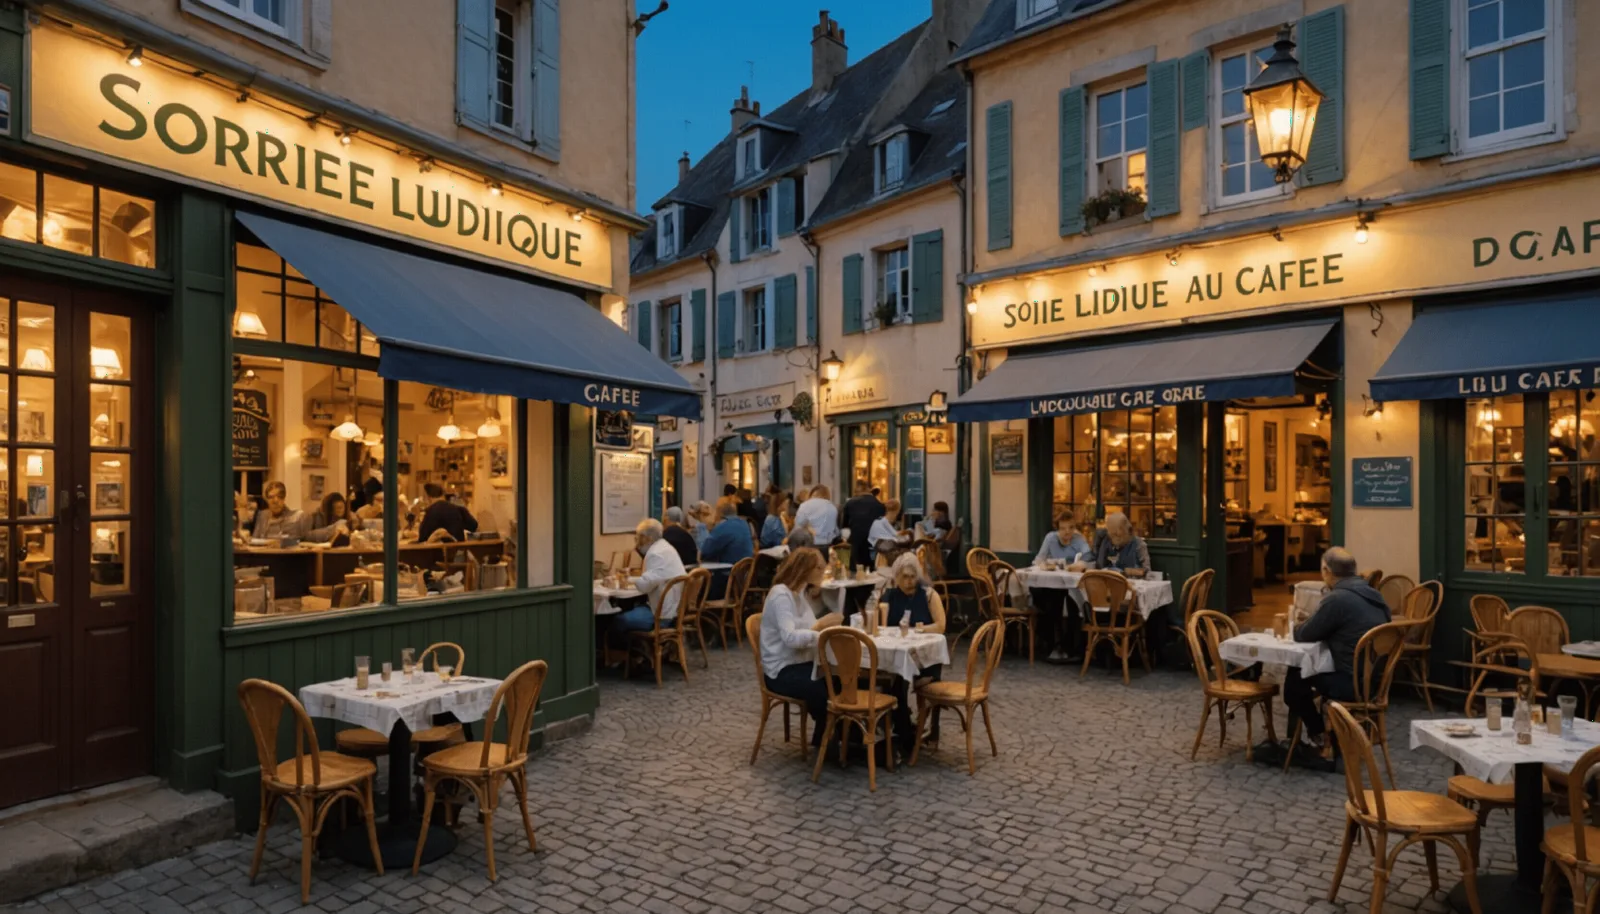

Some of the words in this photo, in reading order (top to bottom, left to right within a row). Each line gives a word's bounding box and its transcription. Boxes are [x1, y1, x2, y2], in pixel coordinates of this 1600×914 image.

[98, 73, 375, 210] SORRIEE
[1185, 272, 1223, 304] AU
[1235, 253, 1345, 296] CAFEE
